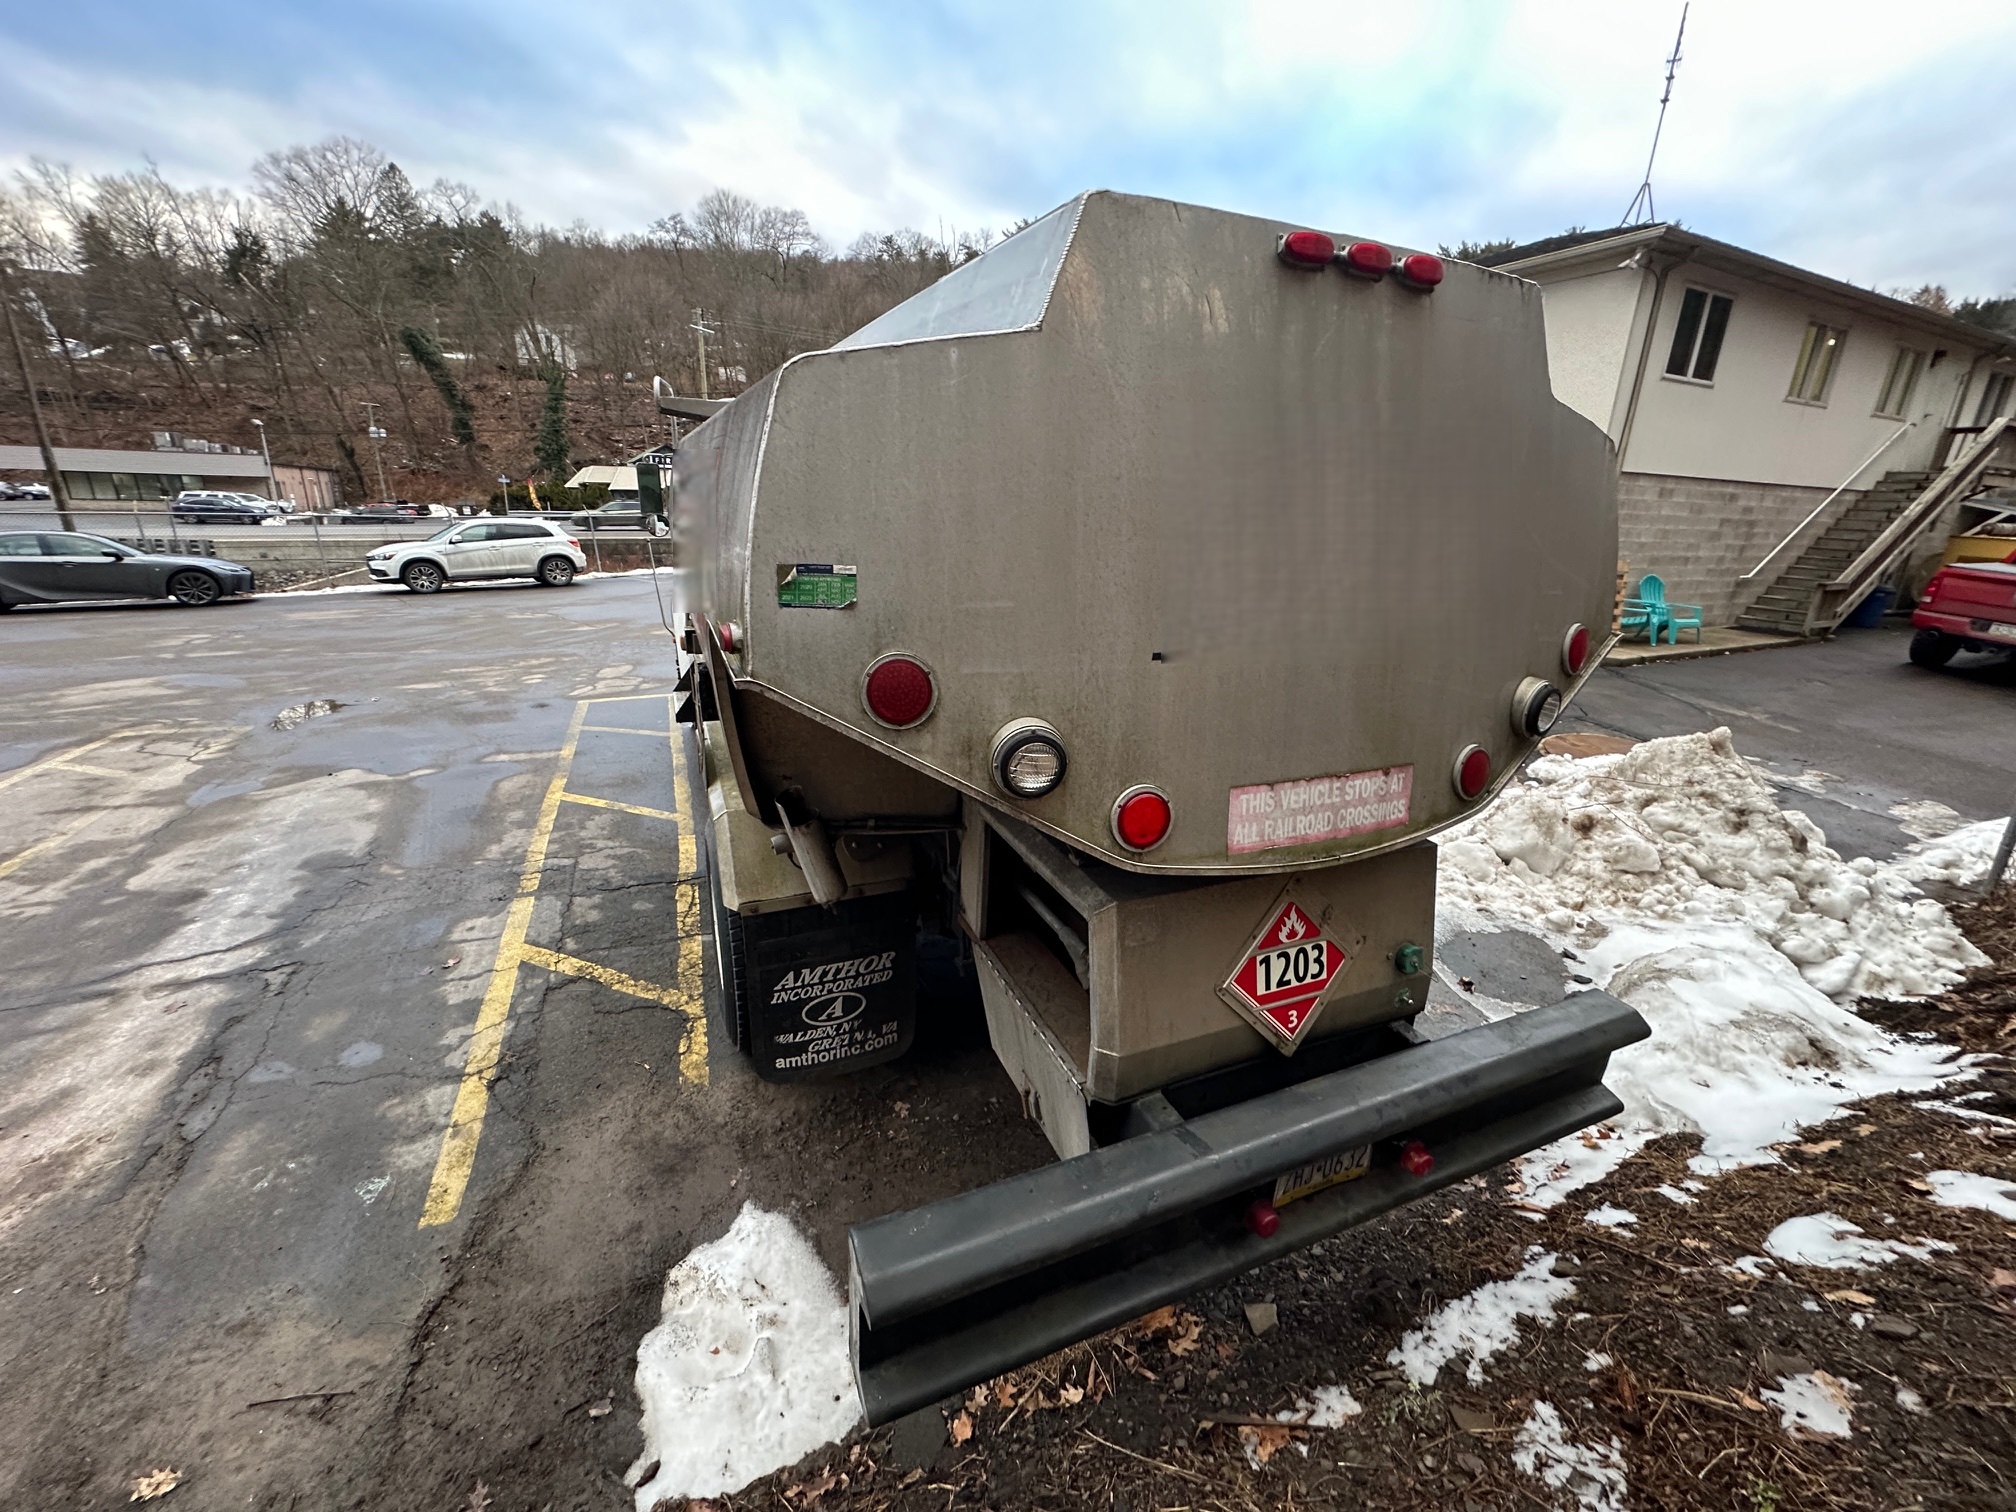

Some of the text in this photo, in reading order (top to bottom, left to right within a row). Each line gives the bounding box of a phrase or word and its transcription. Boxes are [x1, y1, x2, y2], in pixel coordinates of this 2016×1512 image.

[1240, 772, 1406, 815] THIS VEHICLE STOPS AT
[1233, 799, 1407, 845] ALL RAILROAD CROSSINGS
[773, 951, 896, 990] AMTHOR
[1258, 942, 1325, 992] 1203
[770, 970, 893, 1004] INCORPORATED
[818, 996, 844, 1021] A
[1287, 1009, 1298, 1028] 3
[774, 1019, 863, 1044] WALDEN, NY
[881, 1020, 898, 1035] VA
[774, 1032, 898, 1070] amthorinc.com
